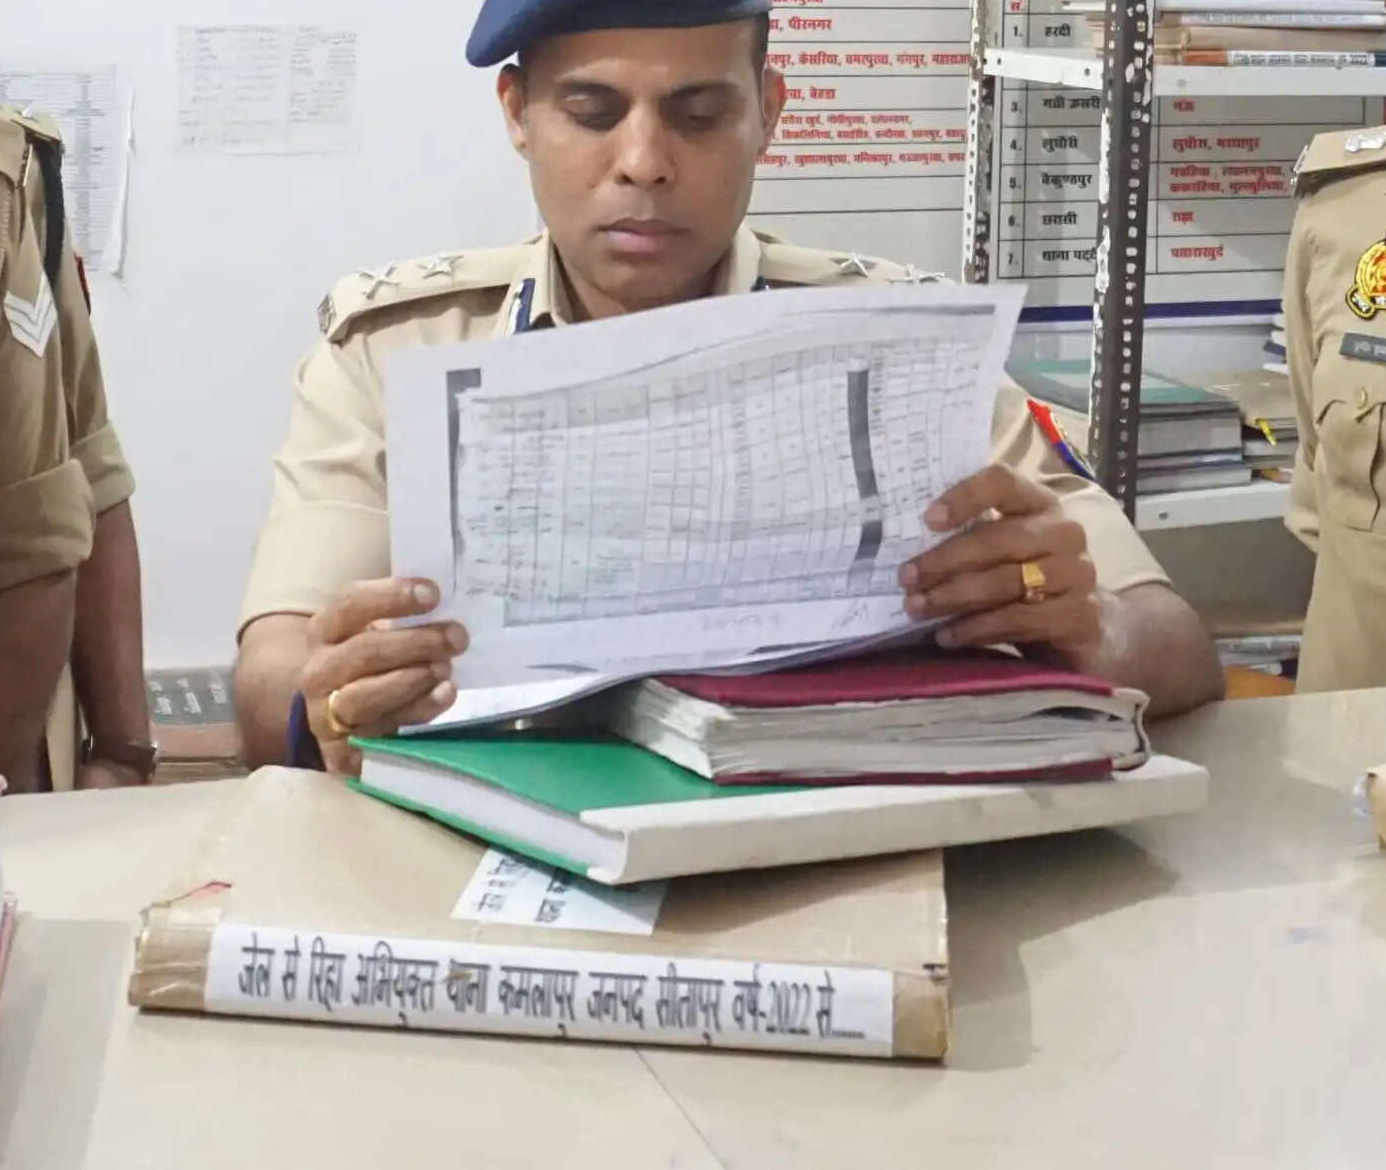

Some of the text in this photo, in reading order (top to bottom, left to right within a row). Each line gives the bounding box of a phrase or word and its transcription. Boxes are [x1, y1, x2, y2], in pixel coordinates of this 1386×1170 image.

[788, 17, 832, 31] पीरनगर
[1045, 23, 1071, 38] हरदी
[238, 931, 275, 998] जेल
[282, 934, 301, 1002] से
[309, 936, 347, 1012] रिहा
[350, 940, 440, 1028] अभियुक्त
[446, 957, 491, 1014] थाना
[498, 963, 580, 1038] कमलापुर
[587, 971, 648, 1030] जनपद
[656, 962, 725, 1046] सीतापुर
